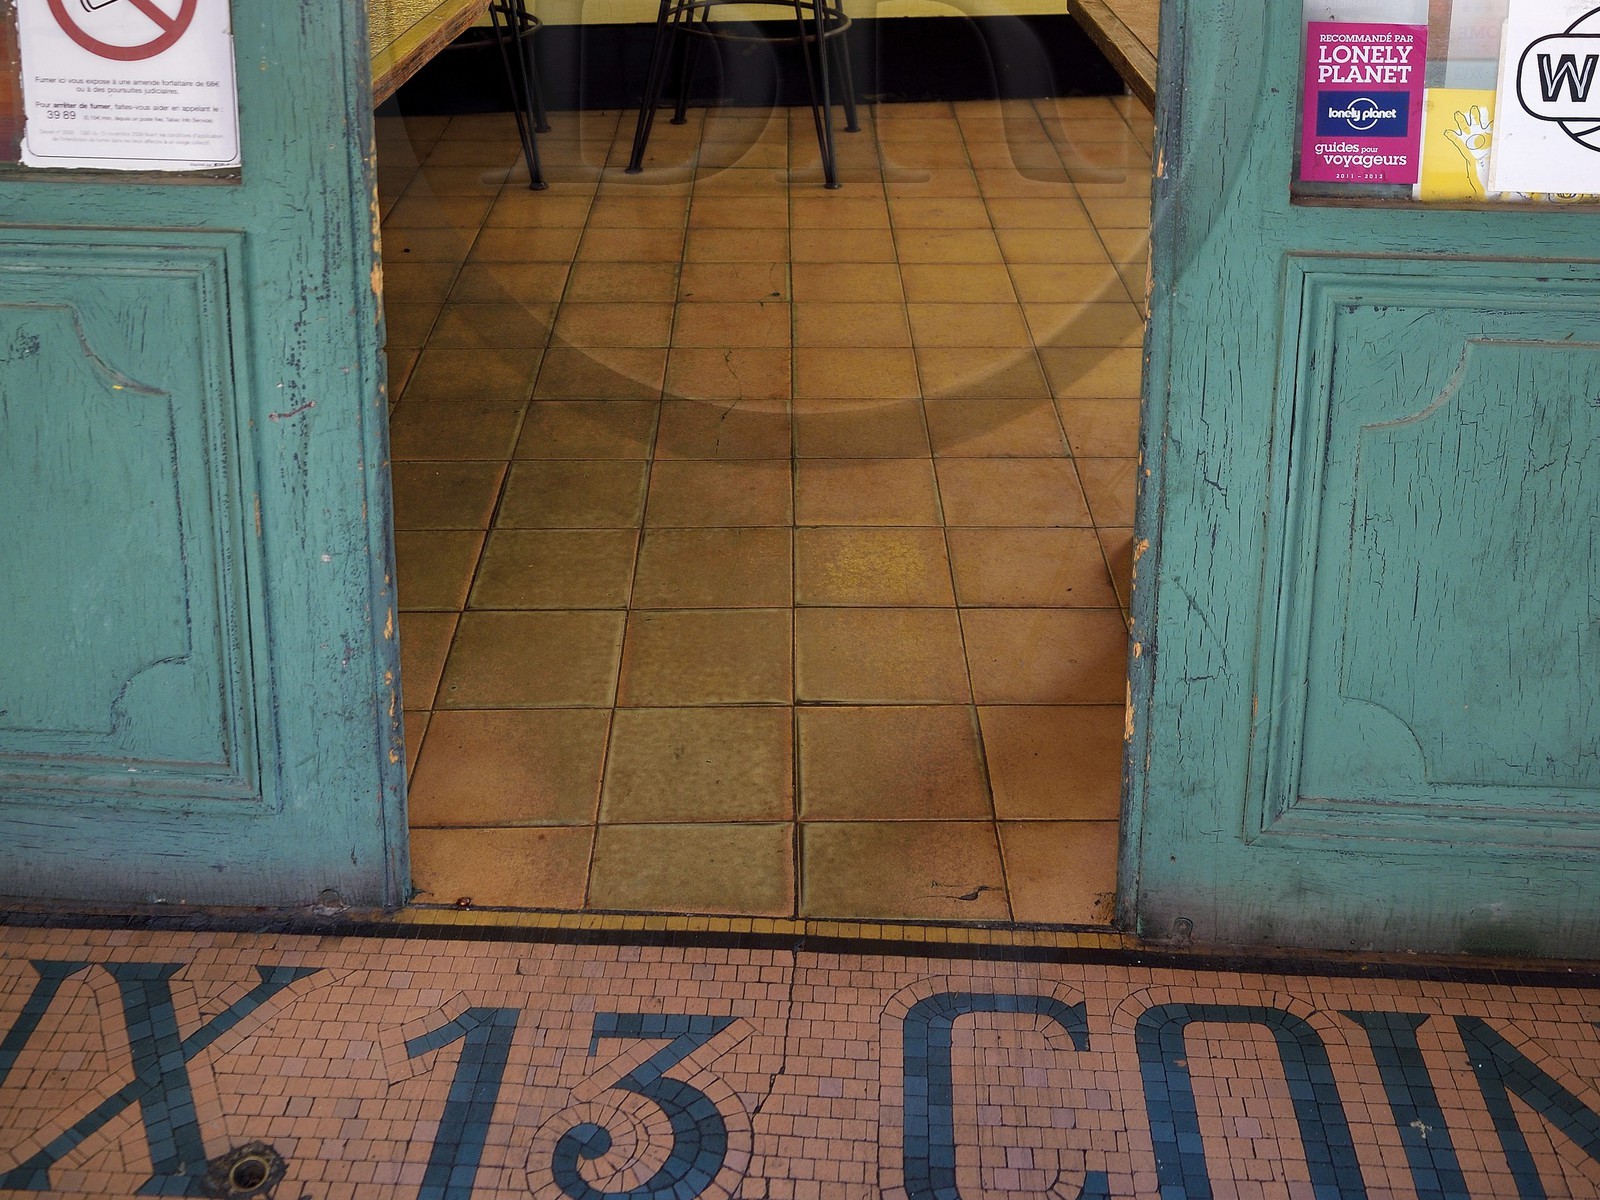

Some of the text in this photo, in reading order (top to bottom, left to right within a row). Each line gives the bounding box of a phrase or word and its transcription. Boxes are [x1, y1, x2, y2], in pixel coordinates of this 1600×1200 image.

[1320, 32, 1392, 43] RECOMMANDÉ
[1319, 46, 1413, 63] LONELY
[1318, 66, 1411, 83] PLANET
[1537, 54, 1599, 102] W
[47, 110, 60, 120] 39
[63, 111, 76, 120] 89
[1328, 107, 1397, 121] lonely planet
[1315, 142, 1359, 154] guides
[1324, 154, 1407, 168] voyageurs
[405, 1006, 745, 1200] 13
